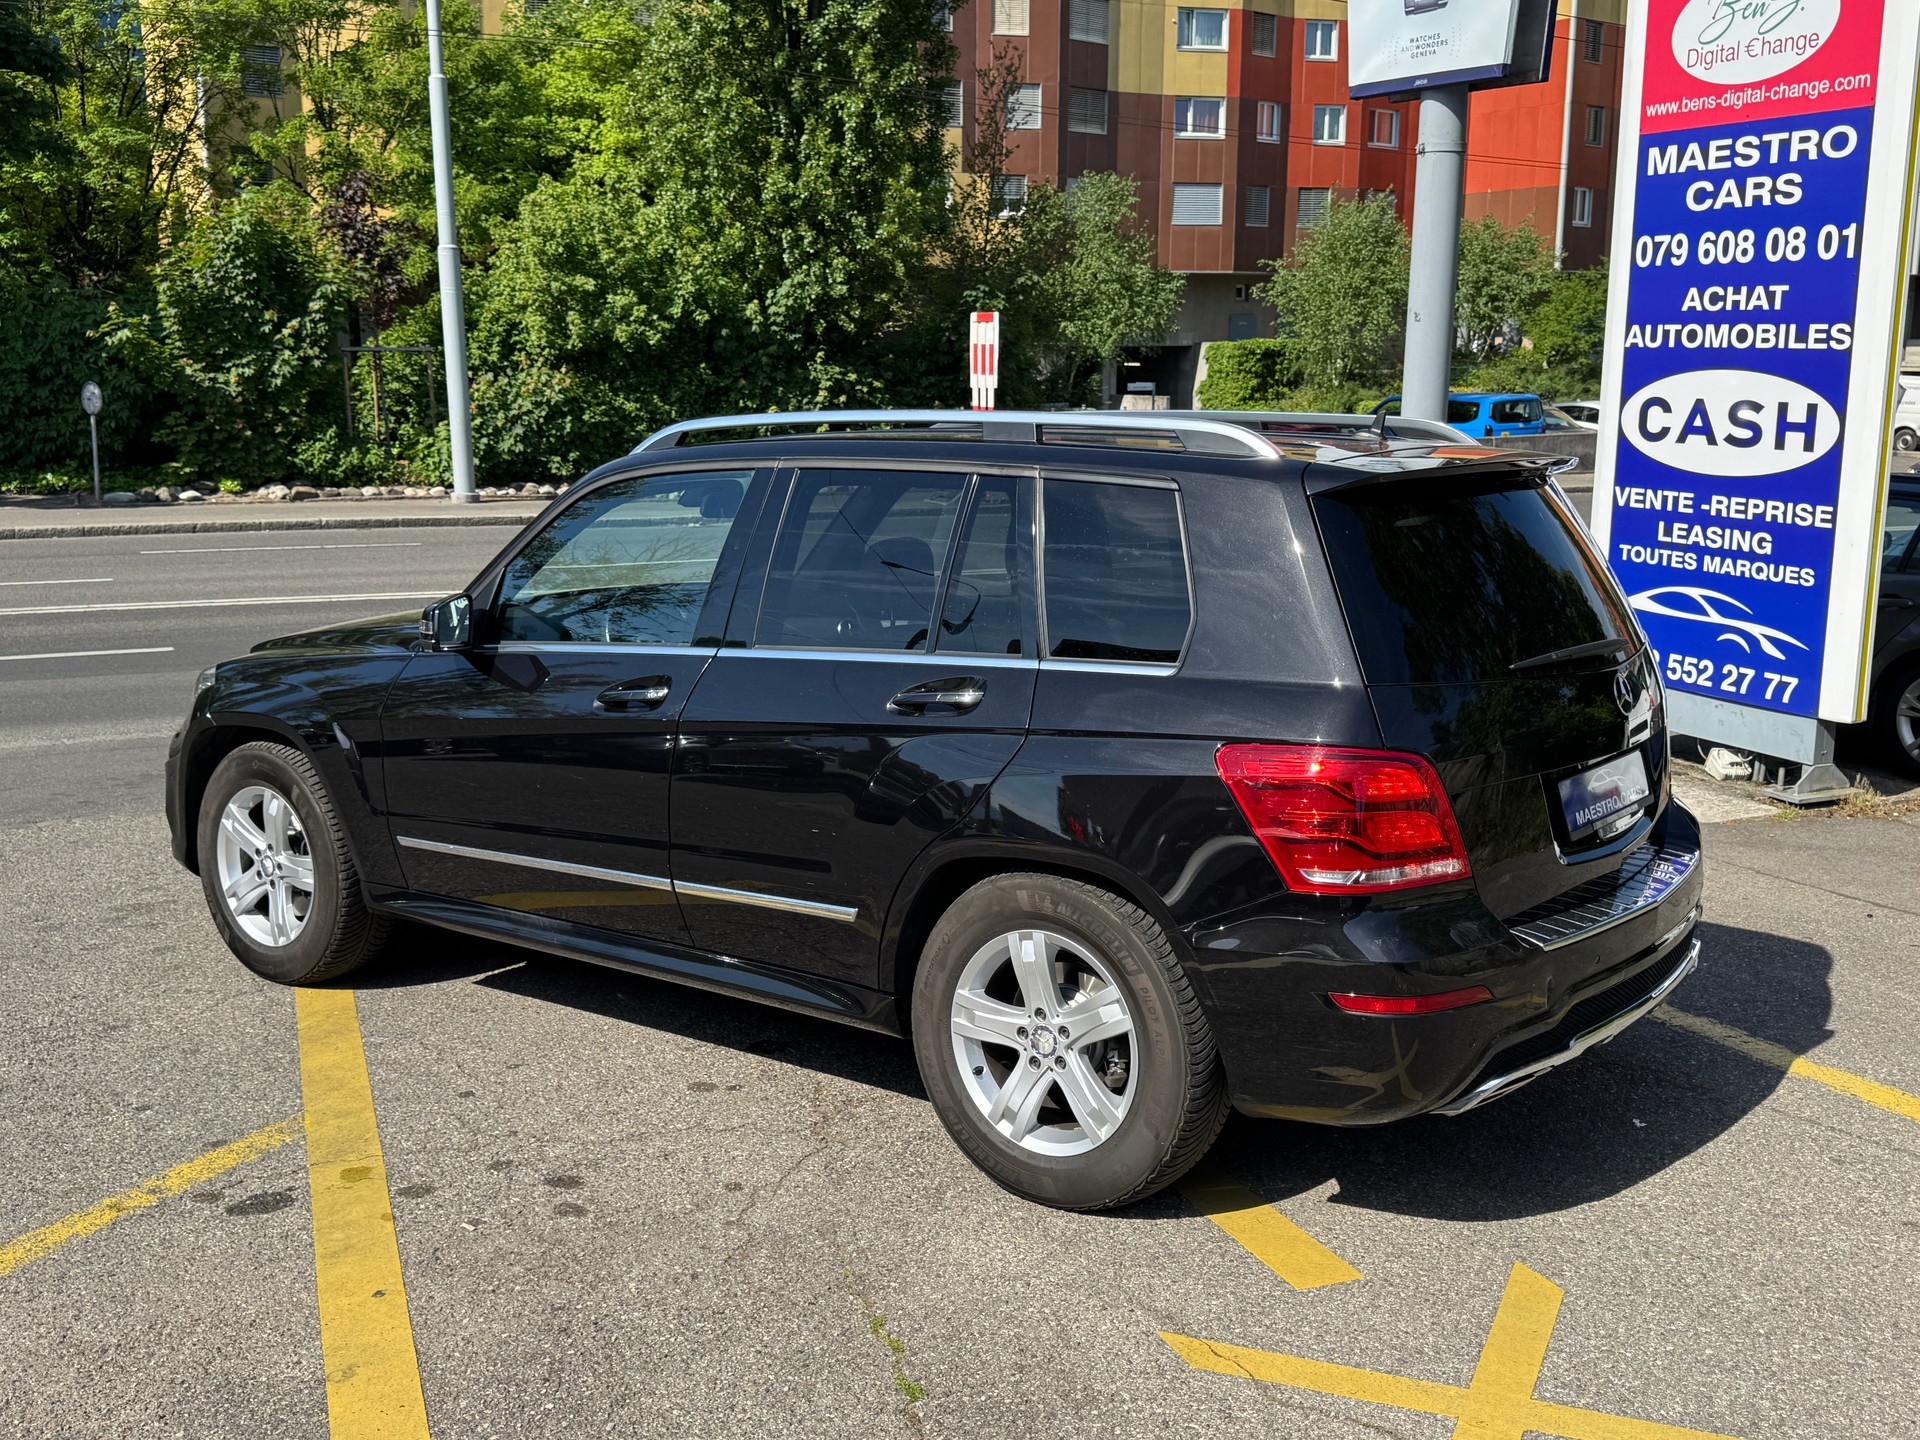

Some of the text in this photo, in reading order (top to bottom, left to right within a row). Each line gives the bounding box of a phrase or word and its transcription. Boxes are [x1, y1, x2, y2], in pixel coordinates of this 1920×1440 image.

[1410, 32, 1440, 43] WATCHES
[1410, 49, 1436, 59] GENEVA
[1686, 40, 1741, 71] Digital
[1646, 73, 1871, 117] www.bens-digital-change.com
[1647, 125, 1858, 176] MAESTRO
[1686, 173, 1803, 212] CARS
[1636, 223, 1857, 268] 079 608 08 01
[1681, 285, 1790, 312] ACHAT
[1624, 324, 1852, 351] AUTOMOBILES
[1638, 397, 1819, 453] CASH
[1614, 486, 1695, 514] VENTE
[1657, 521, 1773, 555] LEASING
[1619, 544, 1815, 587] TOUTES MARQUES
[1667, 653, 1714, 688] 552
[1720, 663, 1756, 695] 27
[1763, 672, 1799, 704] 77
[1056, 902, 1139, 972] MICHELIN
[1138, 986, 1160, 1023] PILOT
